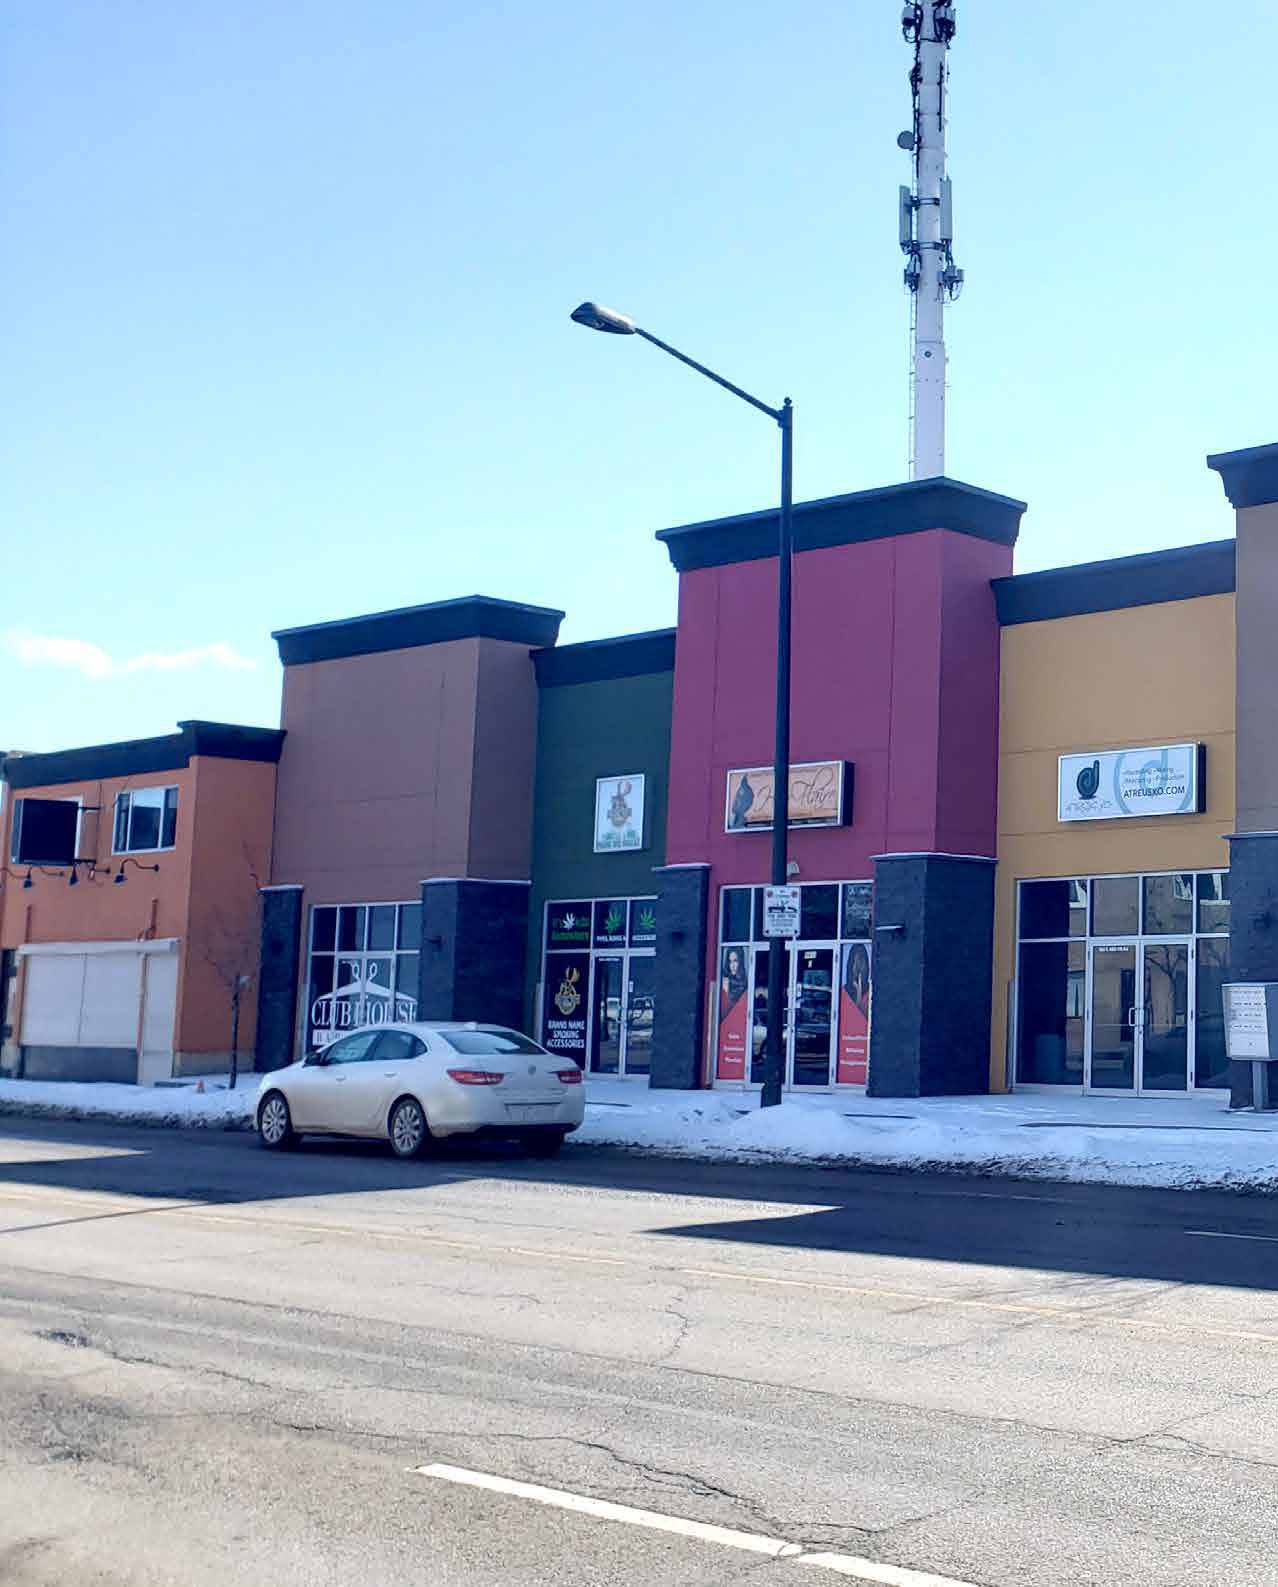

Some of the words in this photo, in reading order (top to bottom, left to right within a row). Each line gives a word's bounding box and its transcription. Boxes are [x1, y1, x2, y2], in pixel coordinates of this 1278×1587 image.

[1123, 785, 1185, 799] ATREUSXO.COM
[568, 1020, 584, 1029] NAME
[546, 1039, 585, 1049] ACCESSORIES
